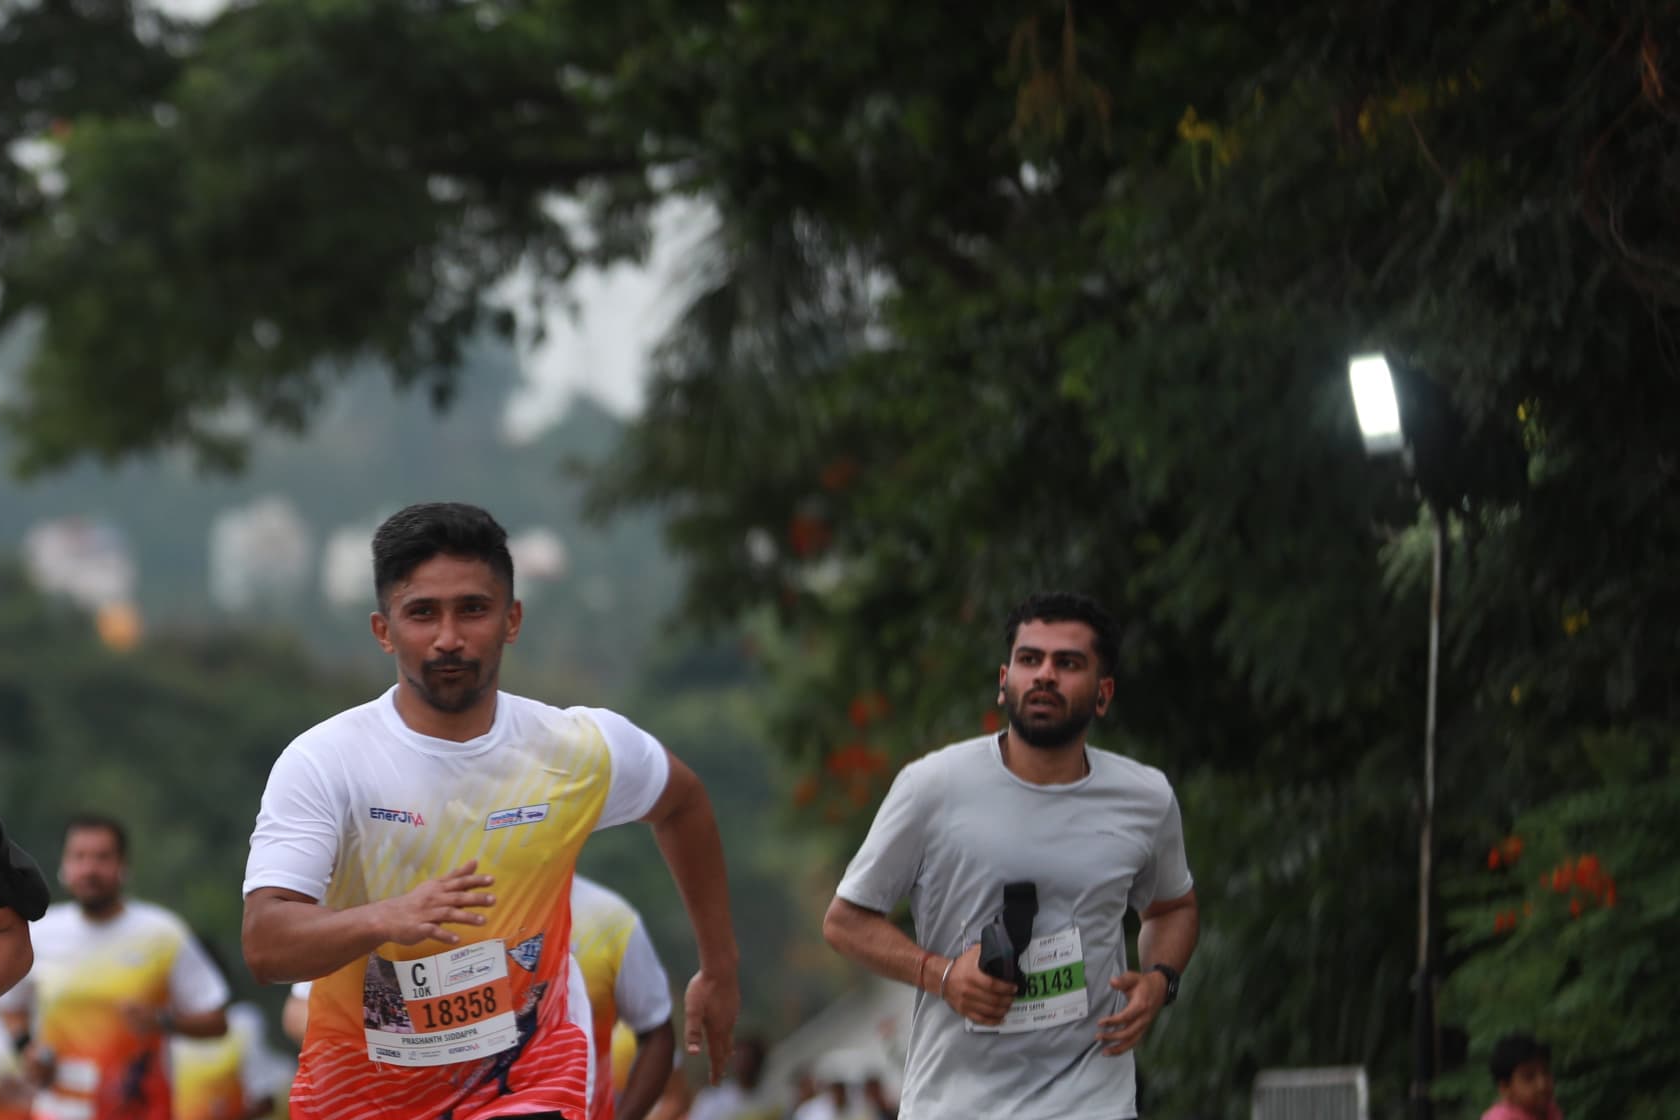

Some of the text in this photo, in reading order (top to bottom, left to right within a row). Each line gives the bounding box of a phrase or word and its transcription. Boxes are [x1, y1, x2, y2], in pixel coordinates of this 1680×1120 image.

[410, 962, 427, 988] C
[1025, 966, 1074, 998] 6143
[413, 985, 432, 999] 10K
[423, 986, 498, 1029] 18358
